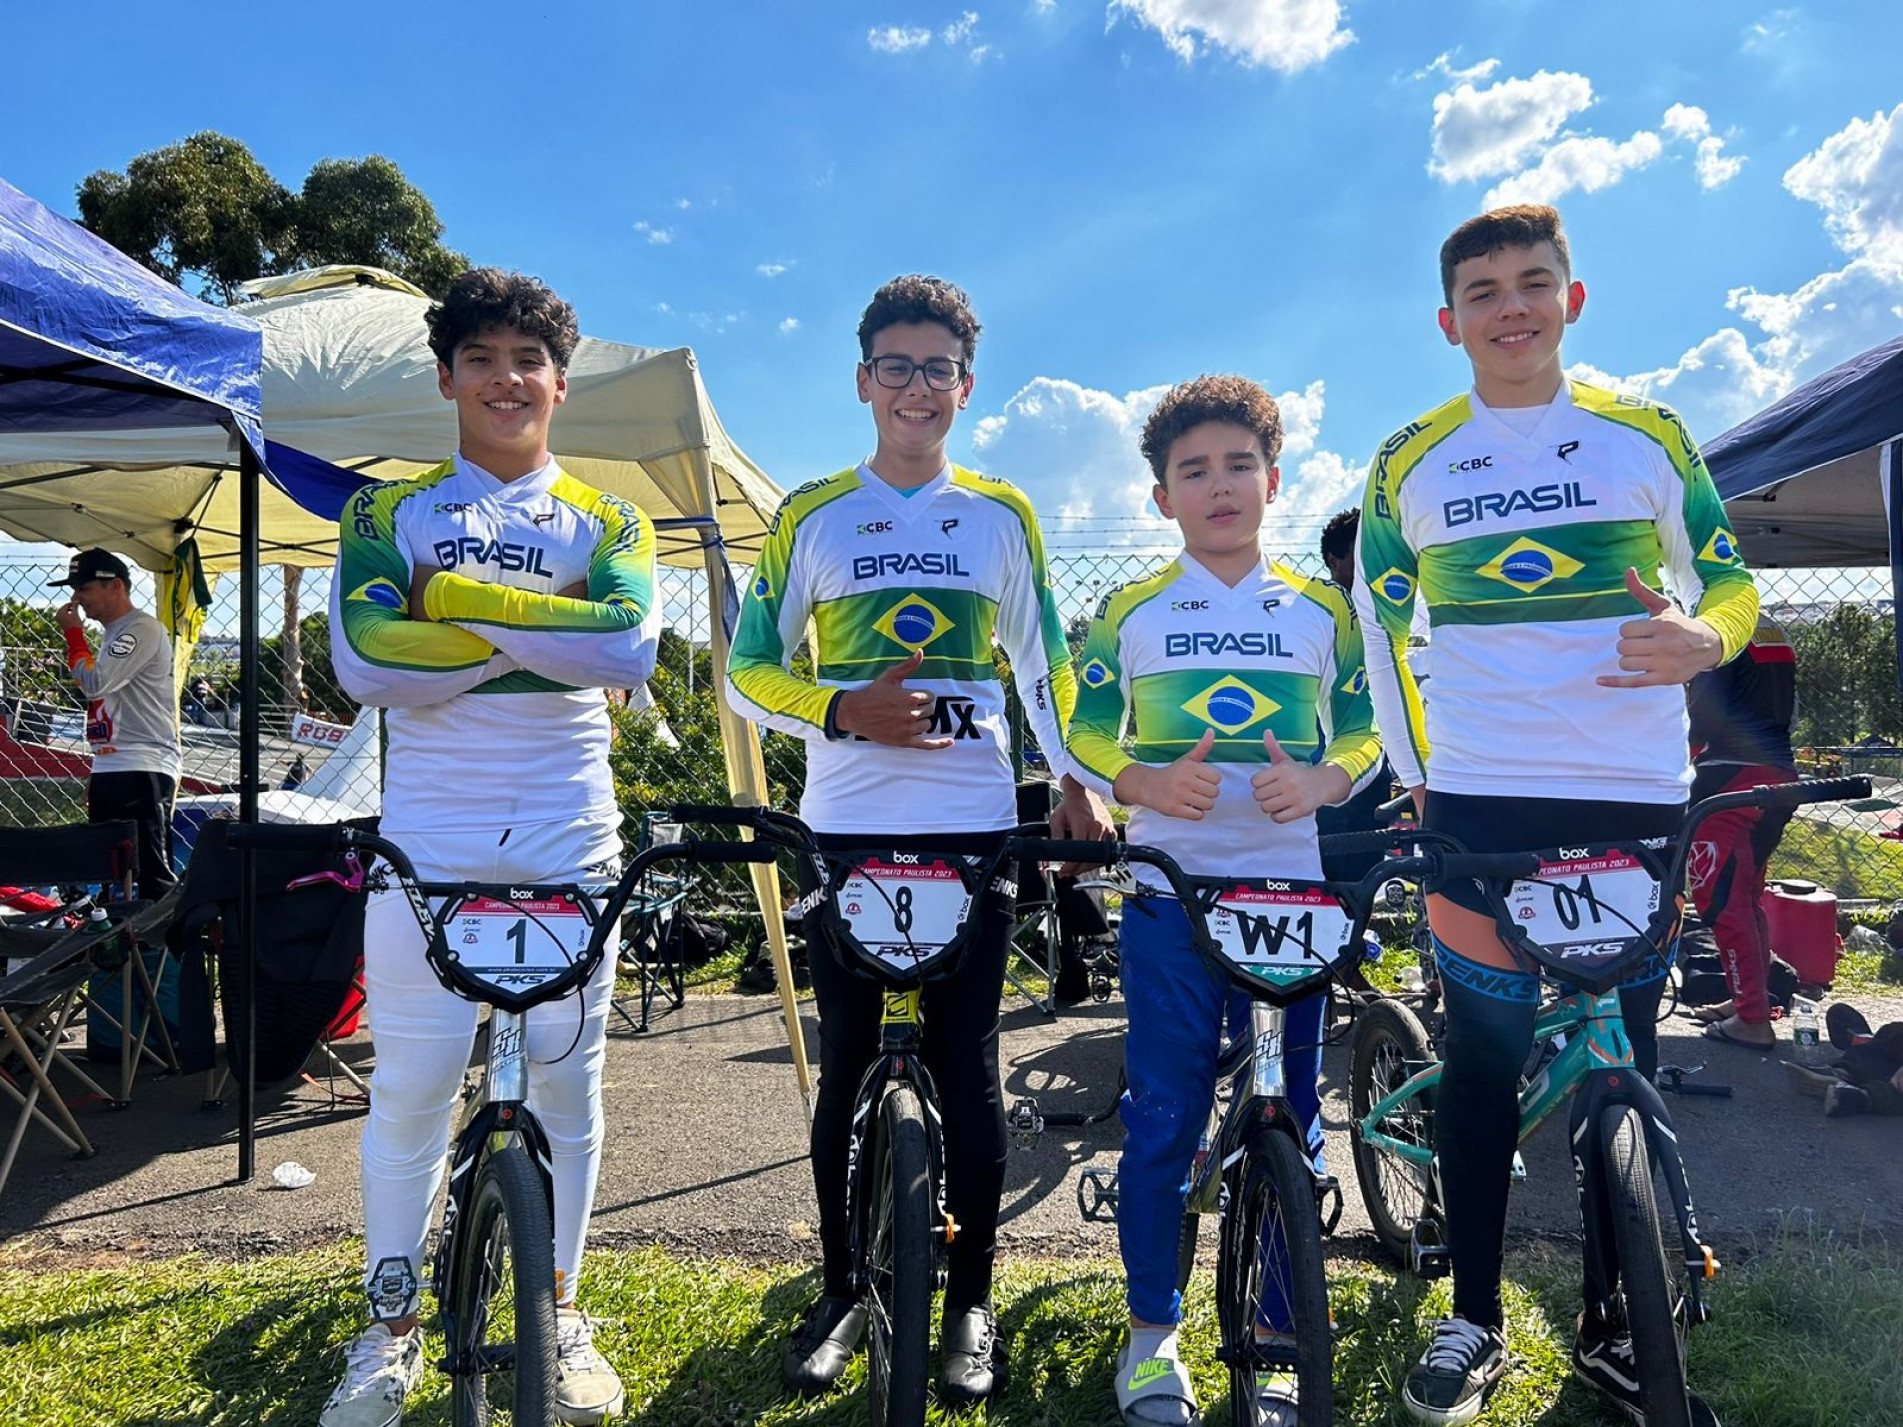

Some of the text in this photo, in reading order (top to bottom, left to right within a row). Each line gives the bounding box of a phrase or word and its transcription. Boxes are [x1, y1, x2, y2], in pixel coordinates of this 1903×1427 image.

[1375, 422, 1432, 519] BRASIL
[1460, 456, 1493, 471] CBC
[1443, 482, 1597, 528] BRASIL
[866, 521, 893, 533] CBC
[433, 536, 553, 579] BRASIL
[853, 552, 970, 580] BRASIL
[1181, 600, 1209, 610] CBC
[1165, 632, 1294, 658] BRASIL
[893, 850, 920, 864] box
[1559, 847, 1590, 860] box
[1538, 866, 1571, 876] PEONATO
[1609, 859, 1630, 868] 2023
[510, 887, 534, 899] box
[1267, 878, 1291, 891] box
[1651, 883, 1660, 902] box
[894, 886, 913, 932] 8
[960, 897, 971, 914] box
[506, 918, 527, 964] 1
[1236, 911, 1314, 959] W1
[876, 945, 934, 957] PKS
[1560, 942, 1626, 959] PKS
[494, 974, 547, 985] PKS
[1261, 966, 1305, 976] PKS
[1135, 1359, 1170, 1378] NIKE
